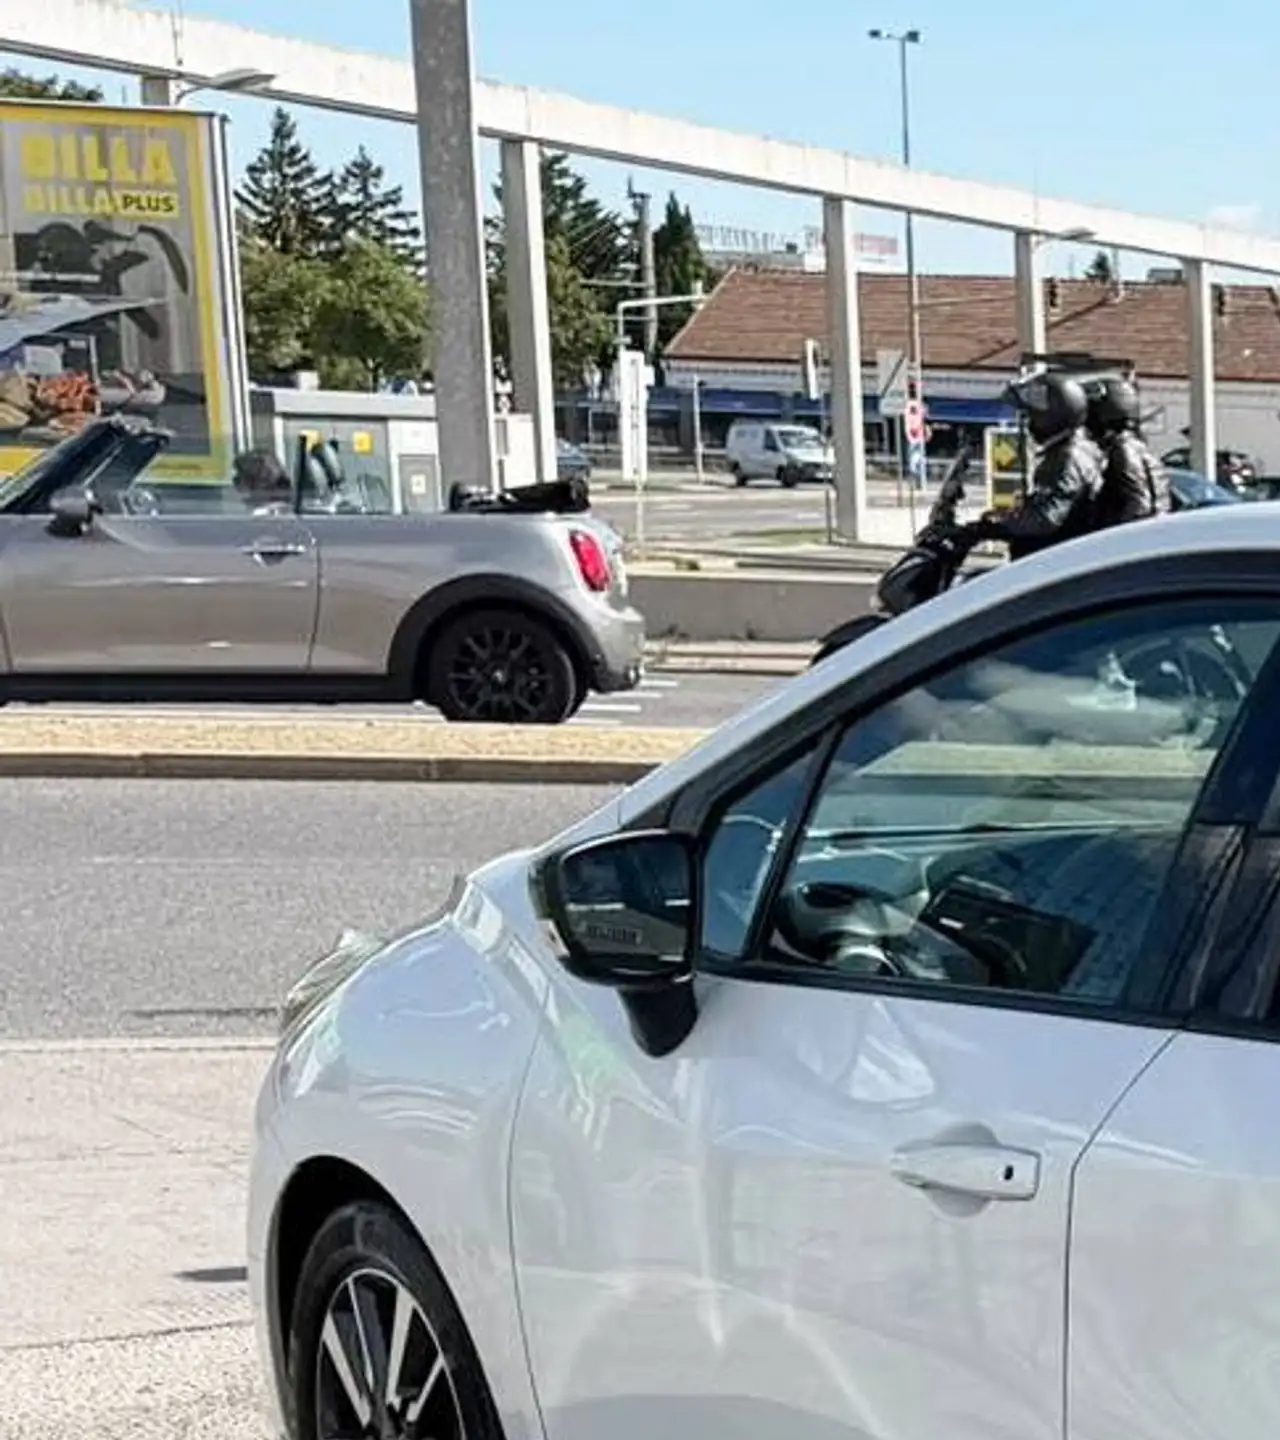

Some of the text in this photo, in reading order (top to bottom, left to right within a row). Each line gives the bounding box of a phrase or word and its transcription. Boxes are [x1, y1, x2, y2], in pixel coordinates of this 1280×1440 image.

[22, 132, 176, 183] BILLA
[24, 184, 175, 214] BILLA PLUS
